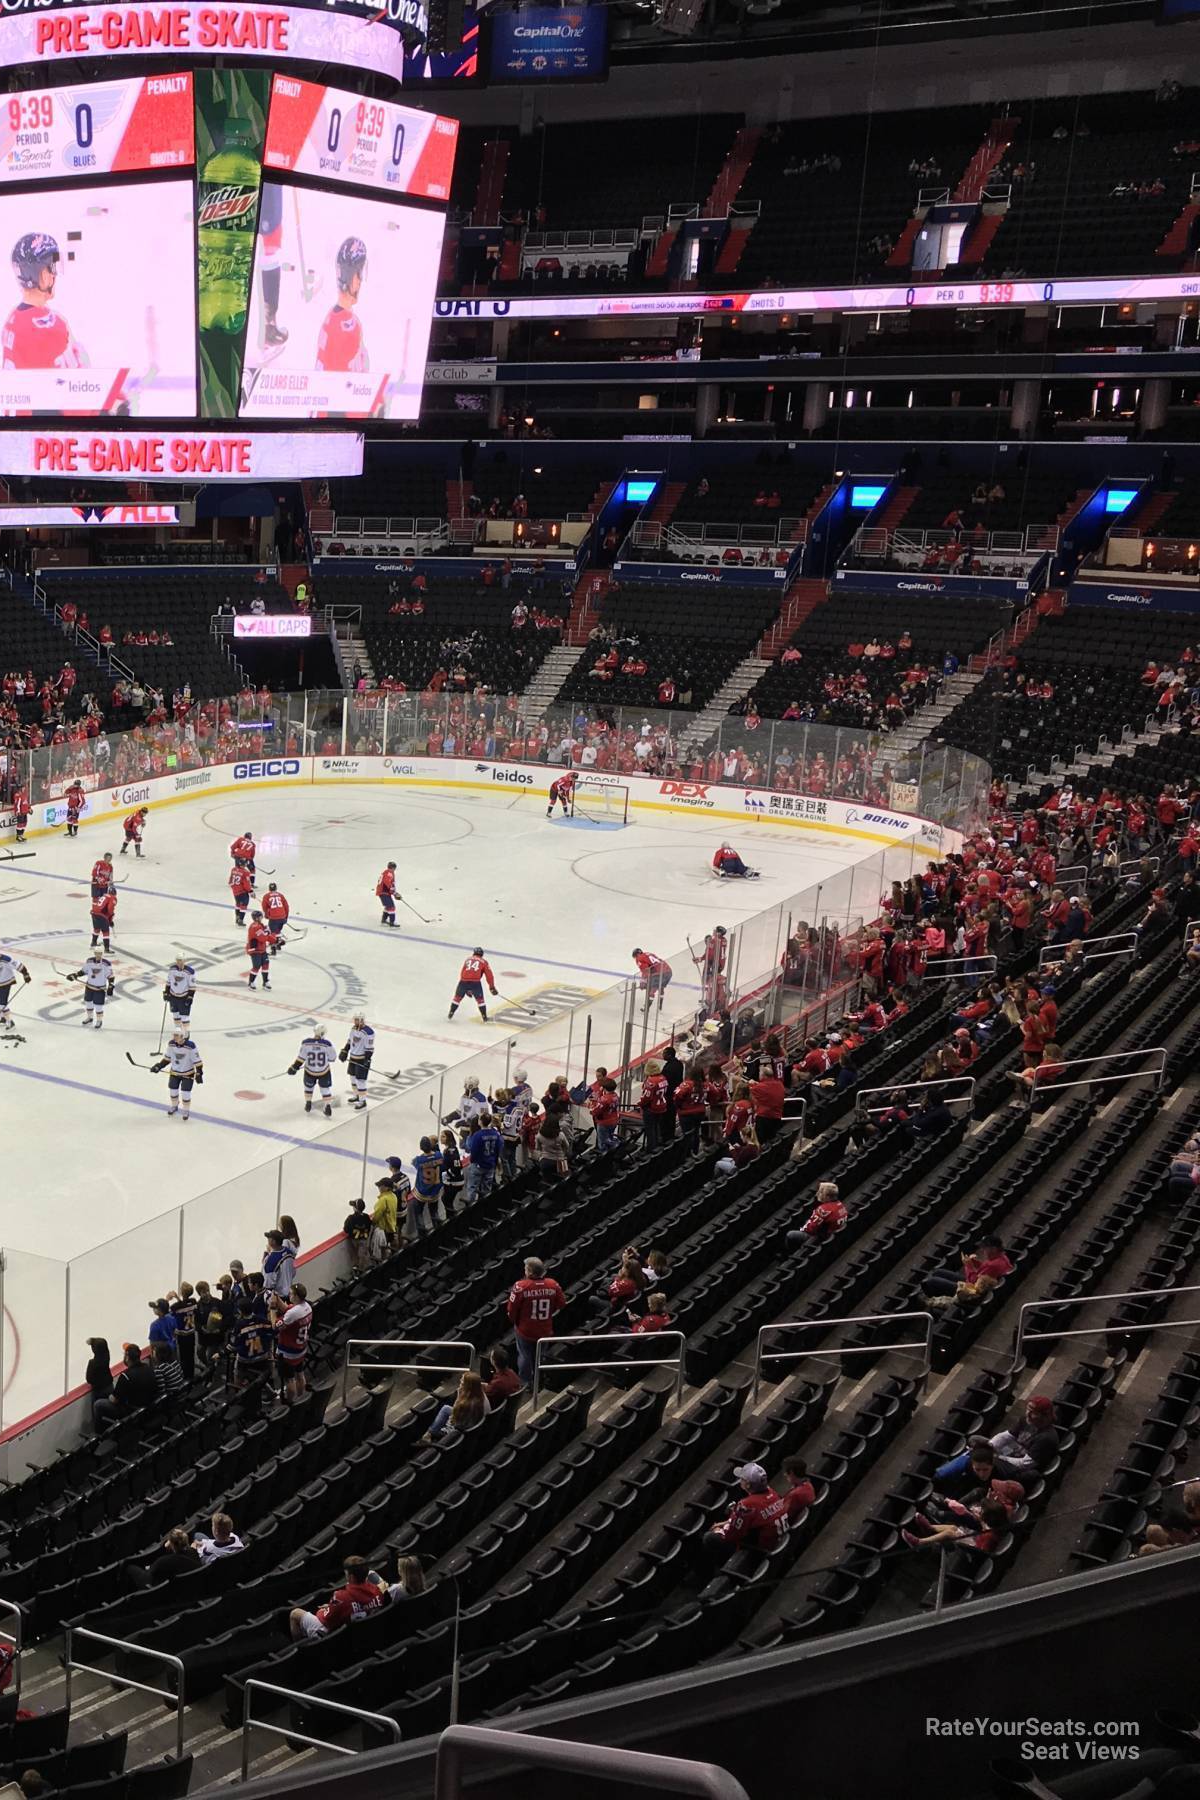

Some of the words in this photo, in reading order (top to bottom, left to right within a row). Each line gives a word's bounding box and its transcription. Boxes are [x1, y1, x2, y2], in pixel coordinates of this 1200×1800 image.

[36, 10, 190, 54] PRE-GAME
[193, 9, 290, 51] SKATE
[147, 77, 188, 95] PENALTY
[275, 78, 301, 98] PENALTY
[8, 95, 54, 131] 9:39
[355, 102, 385, 137] 9:39
[75, 103, 93, 148] 0
[328, 108, 341, 152] 0
[16, 132, 42, 145] PERIOD
[392, 123, 405, 166] 0
[73, 154, 96, 167] BLUES
[906, 288, 915, 305] 0
[936, 290, 954, 301] PER
[980, 284, 1013, 302] 9:39
[1043, 283, 1053, 301] 0
[1181, 283, 1200, 293] SHO
[442, 365, 468, 379] Club
[68, 381, 101, 393] leidos
[260, 377, 270, 389] 20
[270, 377, 288, 389] LARS
[289, 376, 308, 390] ELLER
[352, 385, 372, 397] leidos
[34, 438, 164, 472] PRE-GAME
[170, 439, 252, 473] SKATE
[277, 619, 309, 635] CAPS
[233, 759, 300, 780] GEICO
[392, 764, 415, 775] WGL
[492, 768, 534, 785] leidos
[122, 787, 150, 805] Giant
[659, 781, 712, 801] DEX
[670, 796, 715, 808] imaging
[785, 811, 827, 822] PACKAGING
[863, 813, 910, 830] BOEING
[269, 896, 283, 908] 26
[0, 927, 84, 945] Arena
[464, 959, 482, 972] 34
[307, 1052, 326, 1067] 29
[530, 1299, 551, 1320] 19
